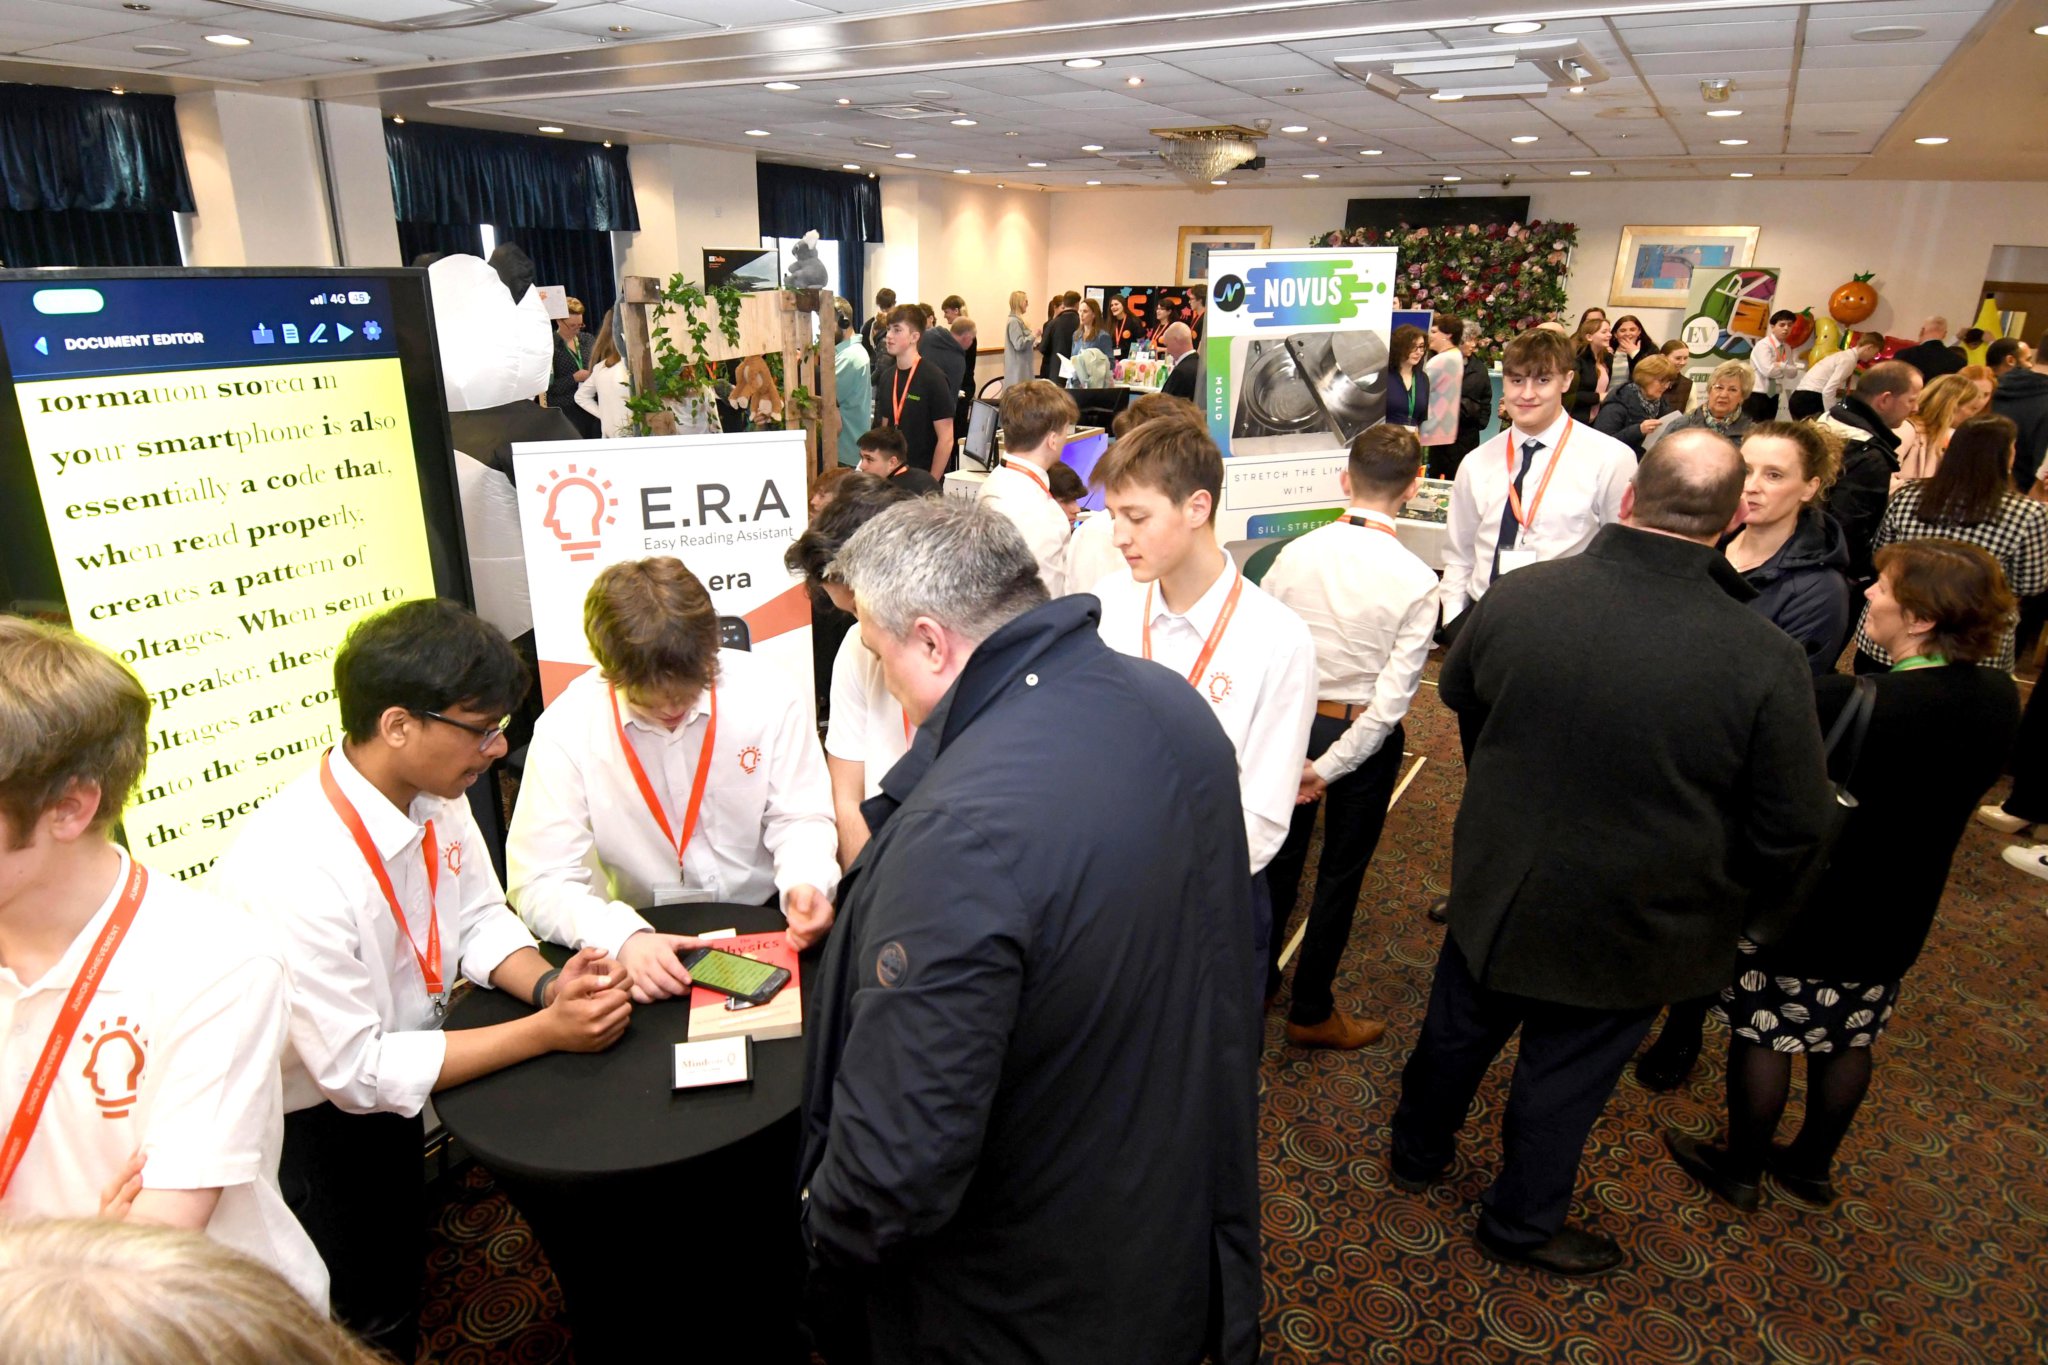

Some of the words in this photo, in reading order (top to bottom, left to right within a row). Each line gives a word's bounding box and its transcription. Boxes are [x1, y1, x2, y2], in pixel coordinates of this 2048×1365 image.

[330, 293, 346, 304] 4G
[1264, 276, 1343, 308] NOVUS
[64, 334, 150, 351] DOCUMENT
[152, 332, 205, 346] EDITOR
[1214, 376, 1223, 421] MOULD
[50, 443, 126, 476] your
[136, 421, 314, 458] smartphone
[322, 415, 342, 436] is
[349, 410, 396, 433] also
[65, 476, 232, 520] essentially
[240, 478, 258, 493] a
[266, 463, 326, 490] code
[1234, 471, 1289, 482] STRETCH
[1295, 467, 1316, 477] THE
[1283, 485, 1313, 495] WITH
[640, 479, 790, 530] E.R.A
[75, 543, 163, 571] when
[172, 522, 239, 554] read
[644, 537, 677, 551] Easy
[680, 531, 733, 548] Reading
[736, 525, 794, 543] Assistant
[89, 585, 200, 621] creates
[209, 579, 227, 596] a
[235, 558, 334, 597] pattern
[342, 544, 367, 568] of
[708, 570, 752, 591] era
[120, 630, 231, 665] oltages.
[238, 605, 317, 635] When
[324, 591, 375, 616] sent
[381, 586, 404, 602] to
[268, 644, 334, 674] these
[147, 716, 240, 756] oltages
[248, 700, 292, 725] are
[202, 760, 246, 783] the
[254, 724, 335, 766] sound
[146, 823, 191, 849] the
[71, 981, 91, 1011] JUNIOR
[86, 924, 120, 981] ACHIEVEMENT
